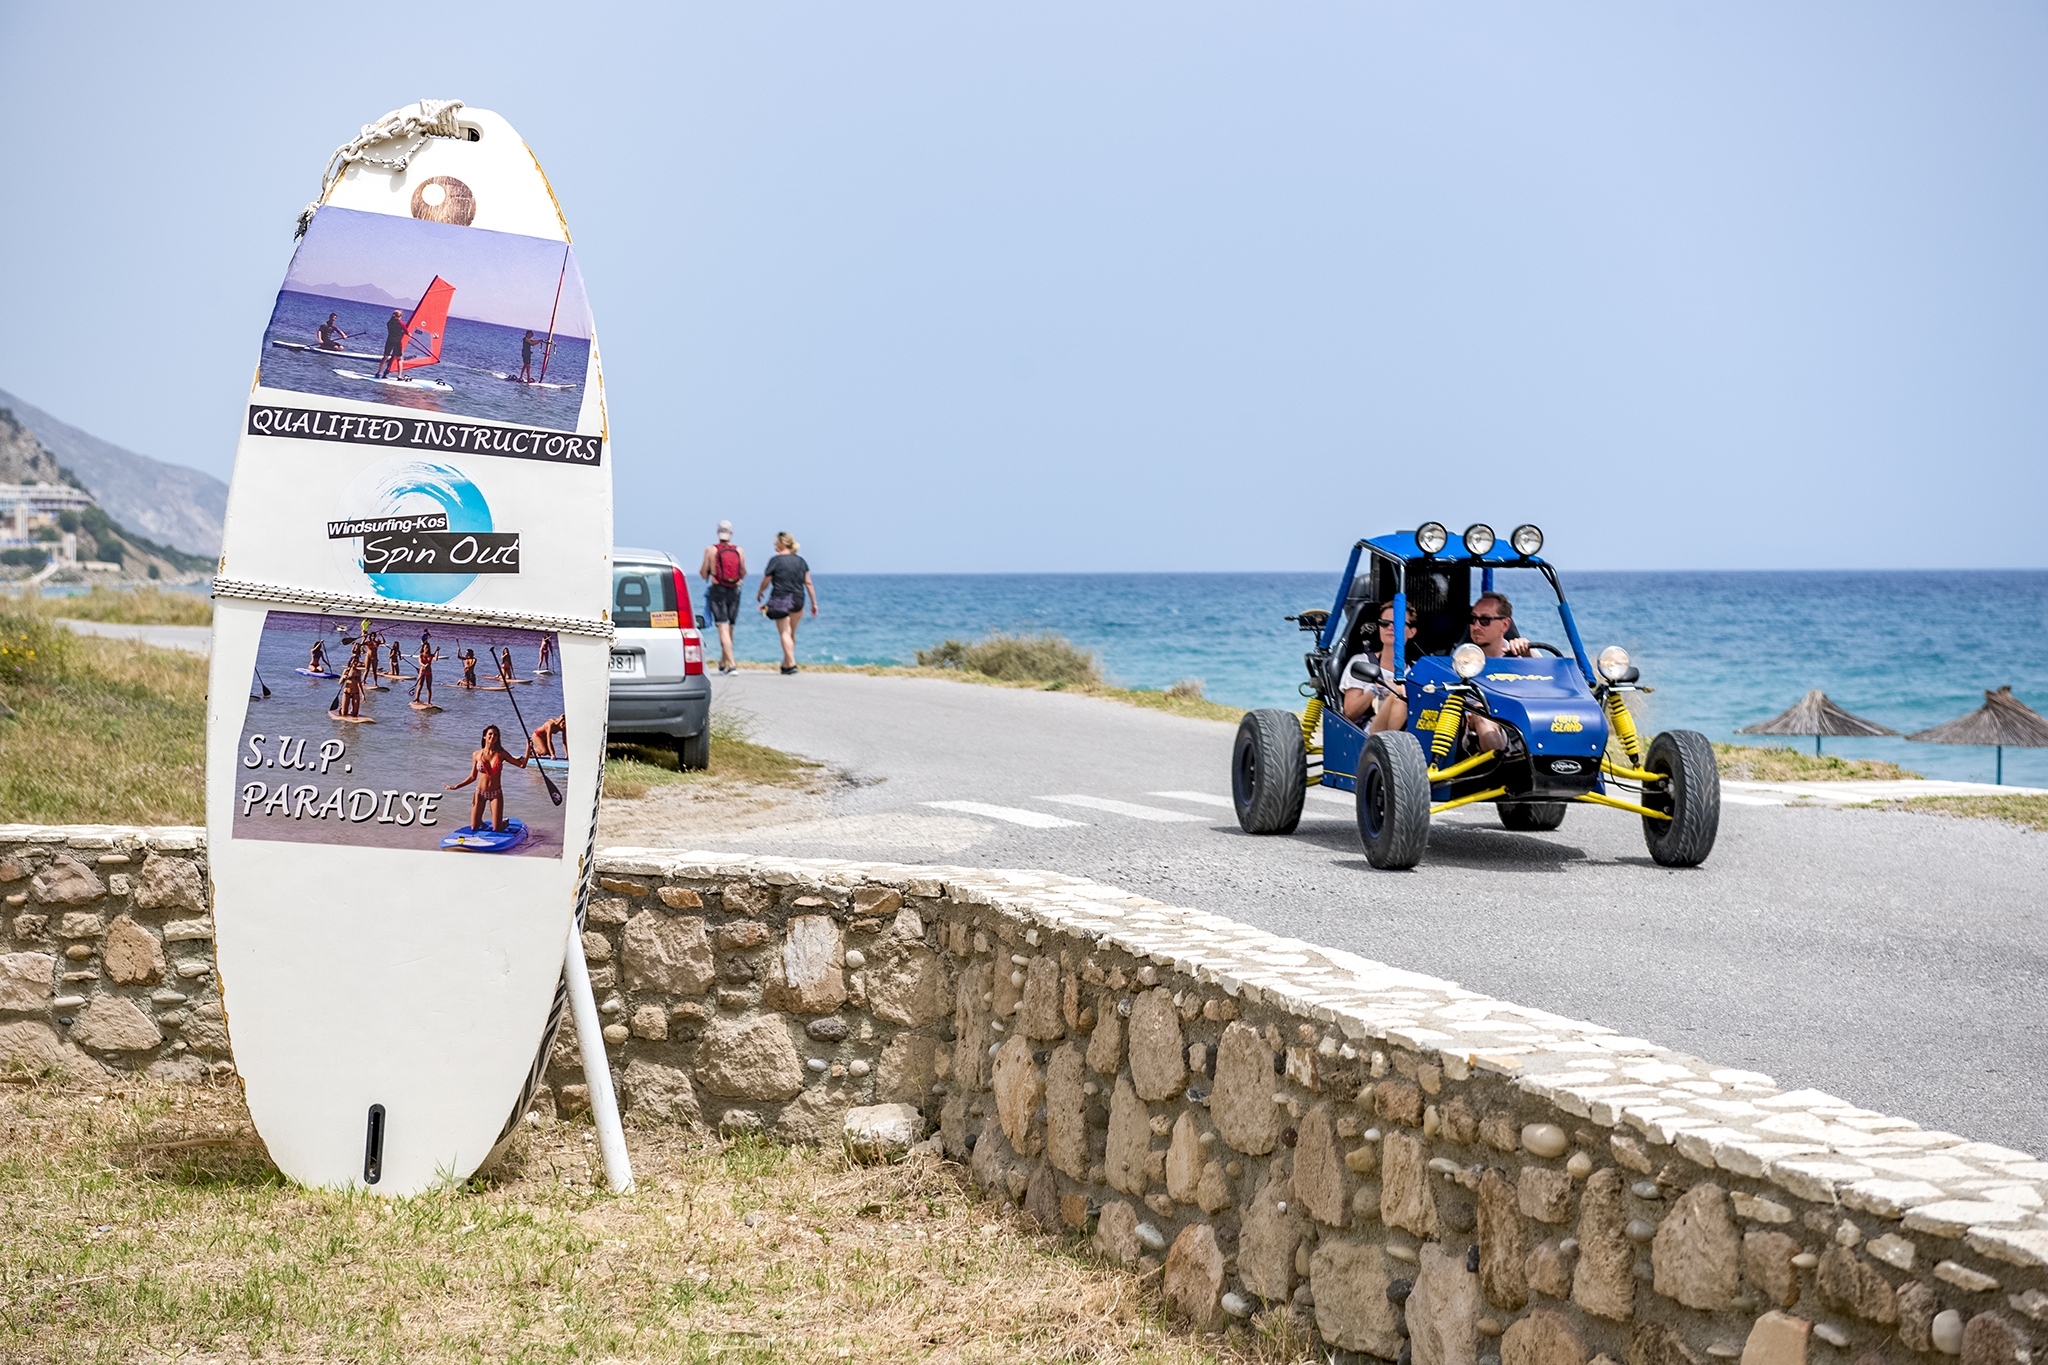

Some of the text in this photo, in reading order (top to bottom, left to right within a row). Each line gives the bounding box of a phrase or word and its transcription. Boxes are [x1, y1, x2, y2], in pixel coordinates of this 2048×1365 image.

[252, 409, 597, 461] QUALIFIED INSTRUCTORS
[329, 514, 446, 536] Windsurfing-Kos
[364, 536, 519, 574] Spin Out
[1551, 722, 1583, 732] ISLAND
[1554, 715, 1579, 724] MOTO
[243, 734, 353, 774] S.U.P.
[242, 781, 443, 826] PARADISE
